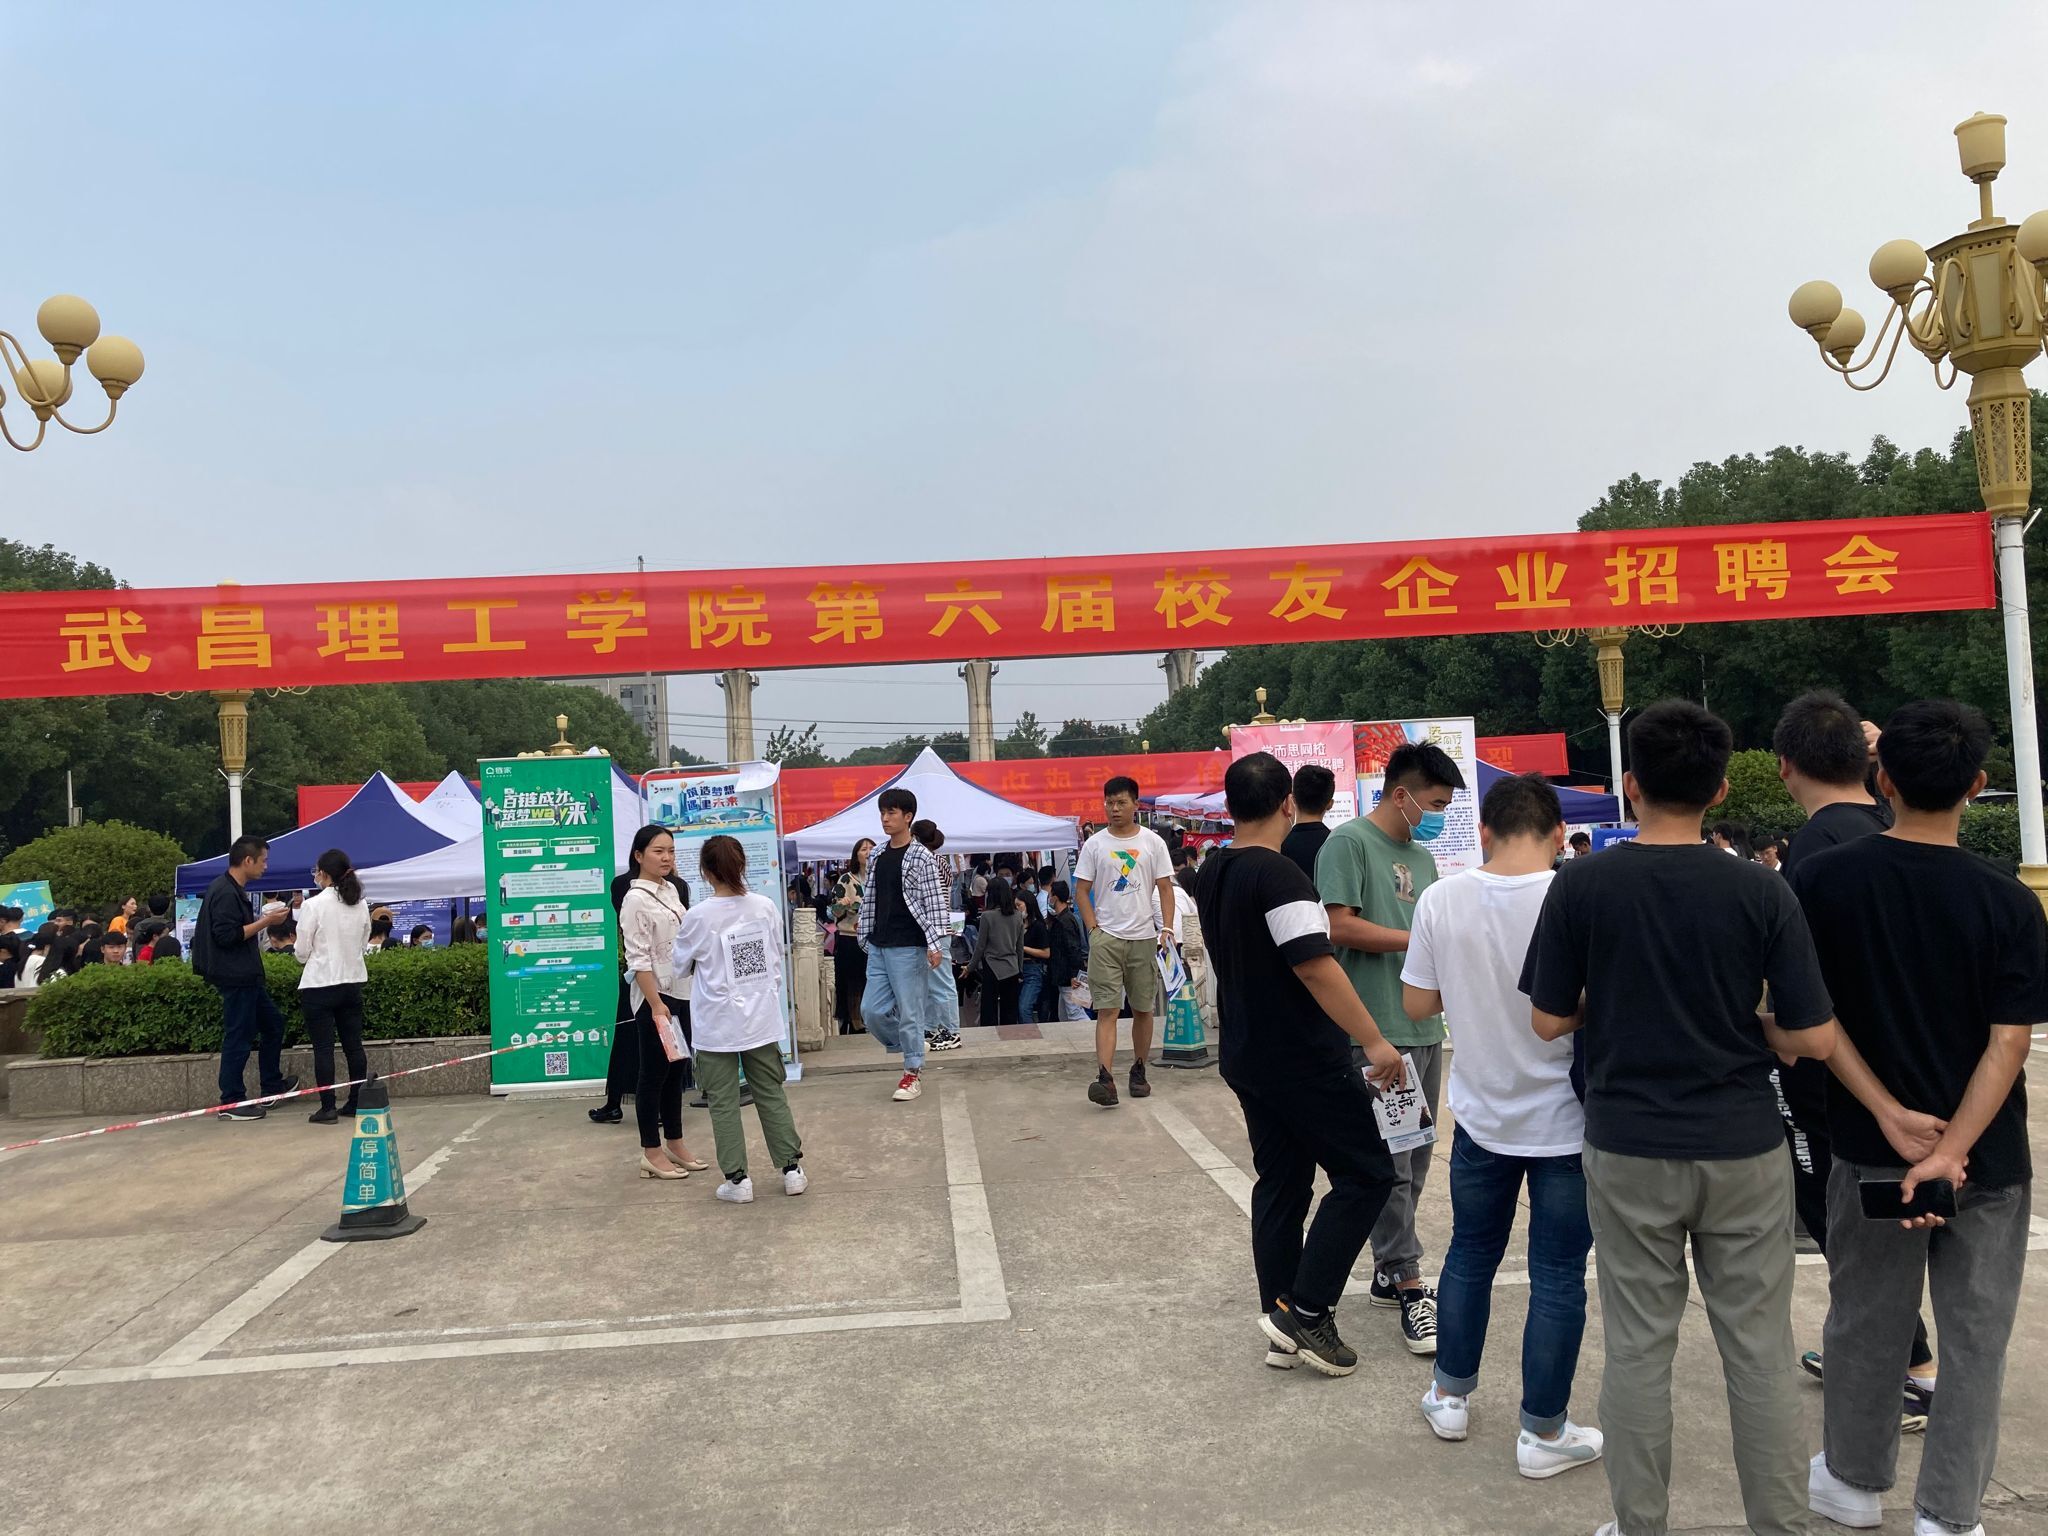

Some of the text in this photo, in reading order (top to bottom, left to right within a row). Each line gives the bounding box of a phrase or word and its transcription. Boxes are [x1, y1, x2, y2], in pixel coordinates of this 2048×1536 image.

[60, 534, 1897, 673] 武昌理工学院第六届校友企业招聘会
[1261, 743, 1327, 758] 学而思网校
[357, 1139, 379, 1203] 停简单
